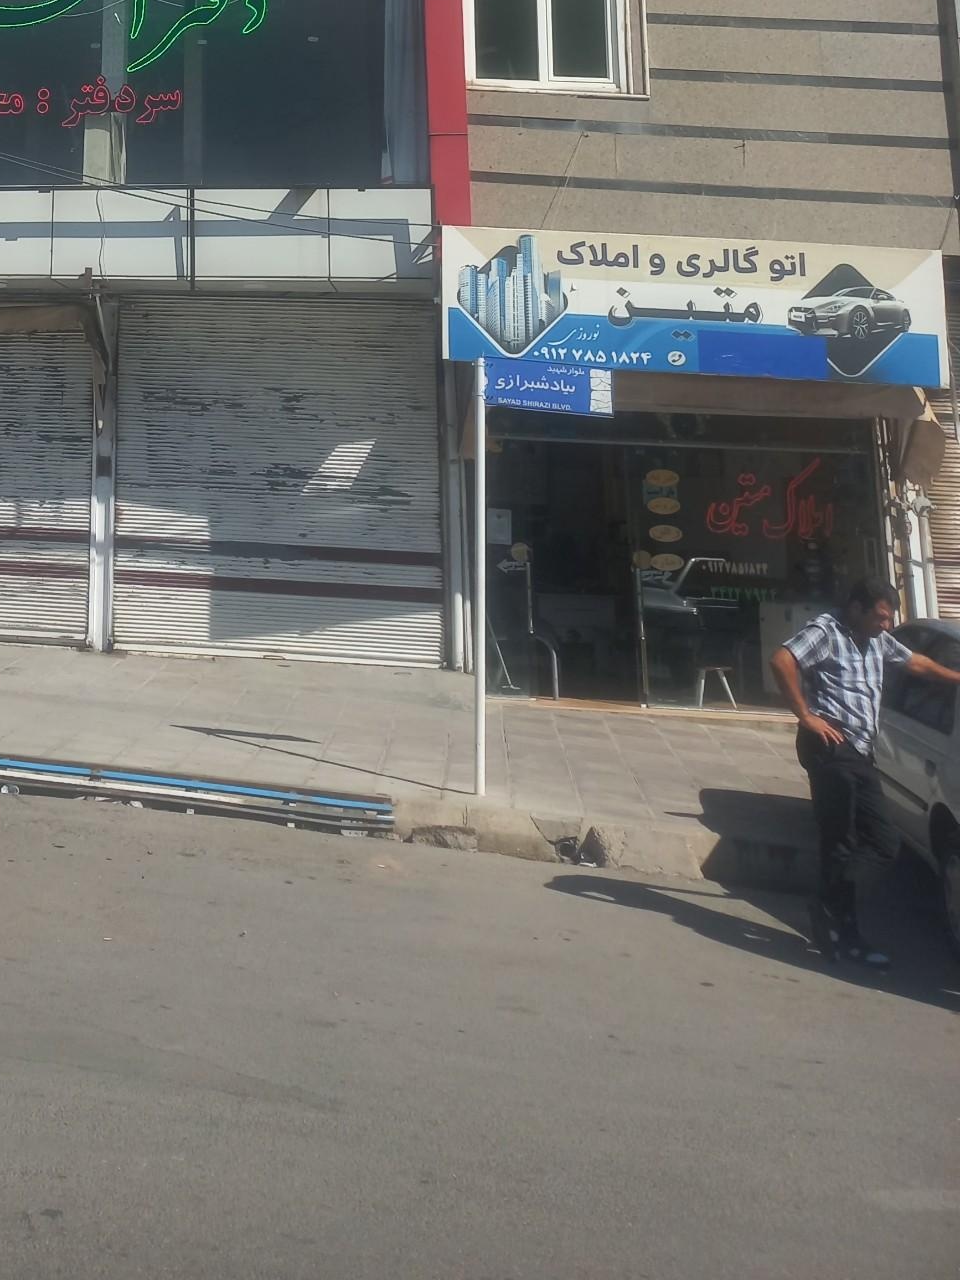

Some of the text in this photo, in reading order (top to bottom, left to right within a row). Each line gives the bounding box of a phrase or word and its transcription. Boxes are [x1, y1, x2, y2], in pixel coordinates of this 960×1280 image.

[556, 240, 807, 281] اتو گالری و املاک
[607, 286, 764, 342] متین
[532, 346, 653, 365] ۰۹۱۲ ۷۸۵ ۱۸۲۴
[497, 397, 521, 406] SAYAD
[522, 399, 551, 409] SHIRAZI
[706, 455, 834, 539] املاک متین
